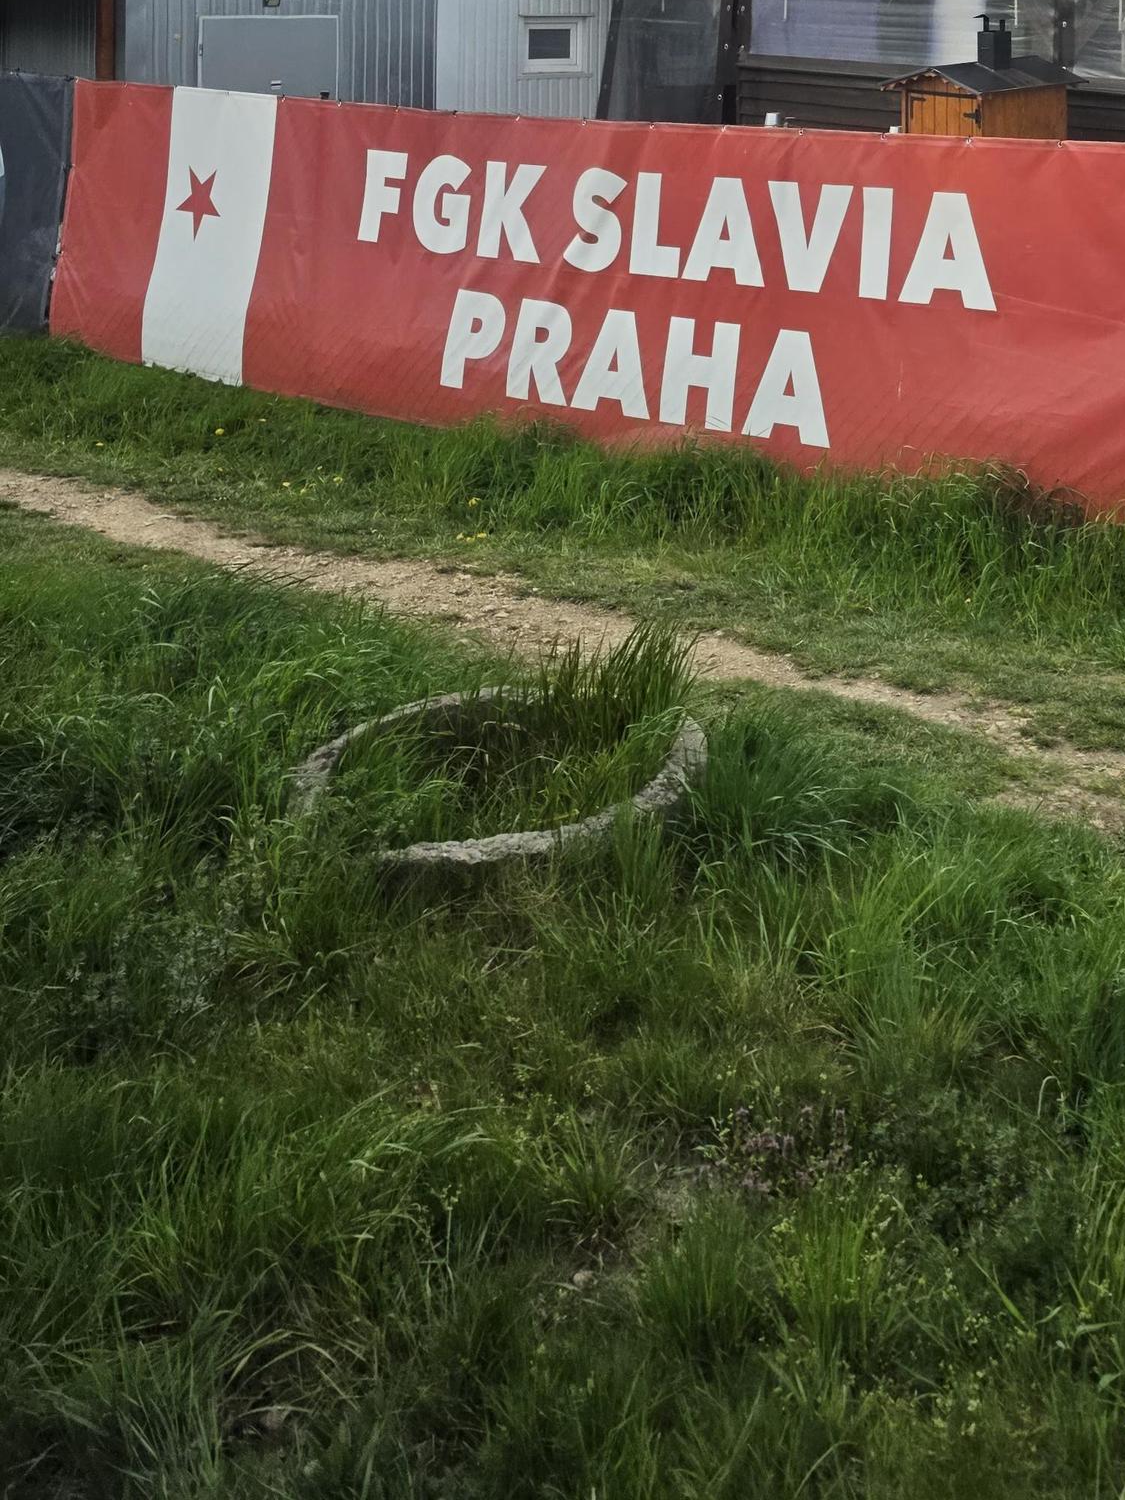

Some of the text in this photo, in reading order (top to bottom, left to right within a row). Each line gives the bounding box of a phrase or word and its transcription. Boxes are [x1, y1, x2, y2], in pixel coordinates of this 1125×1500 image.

[357, 149, 998, 312] FGK SLAVIA
[440, 289, 831, 449] PRAHA
